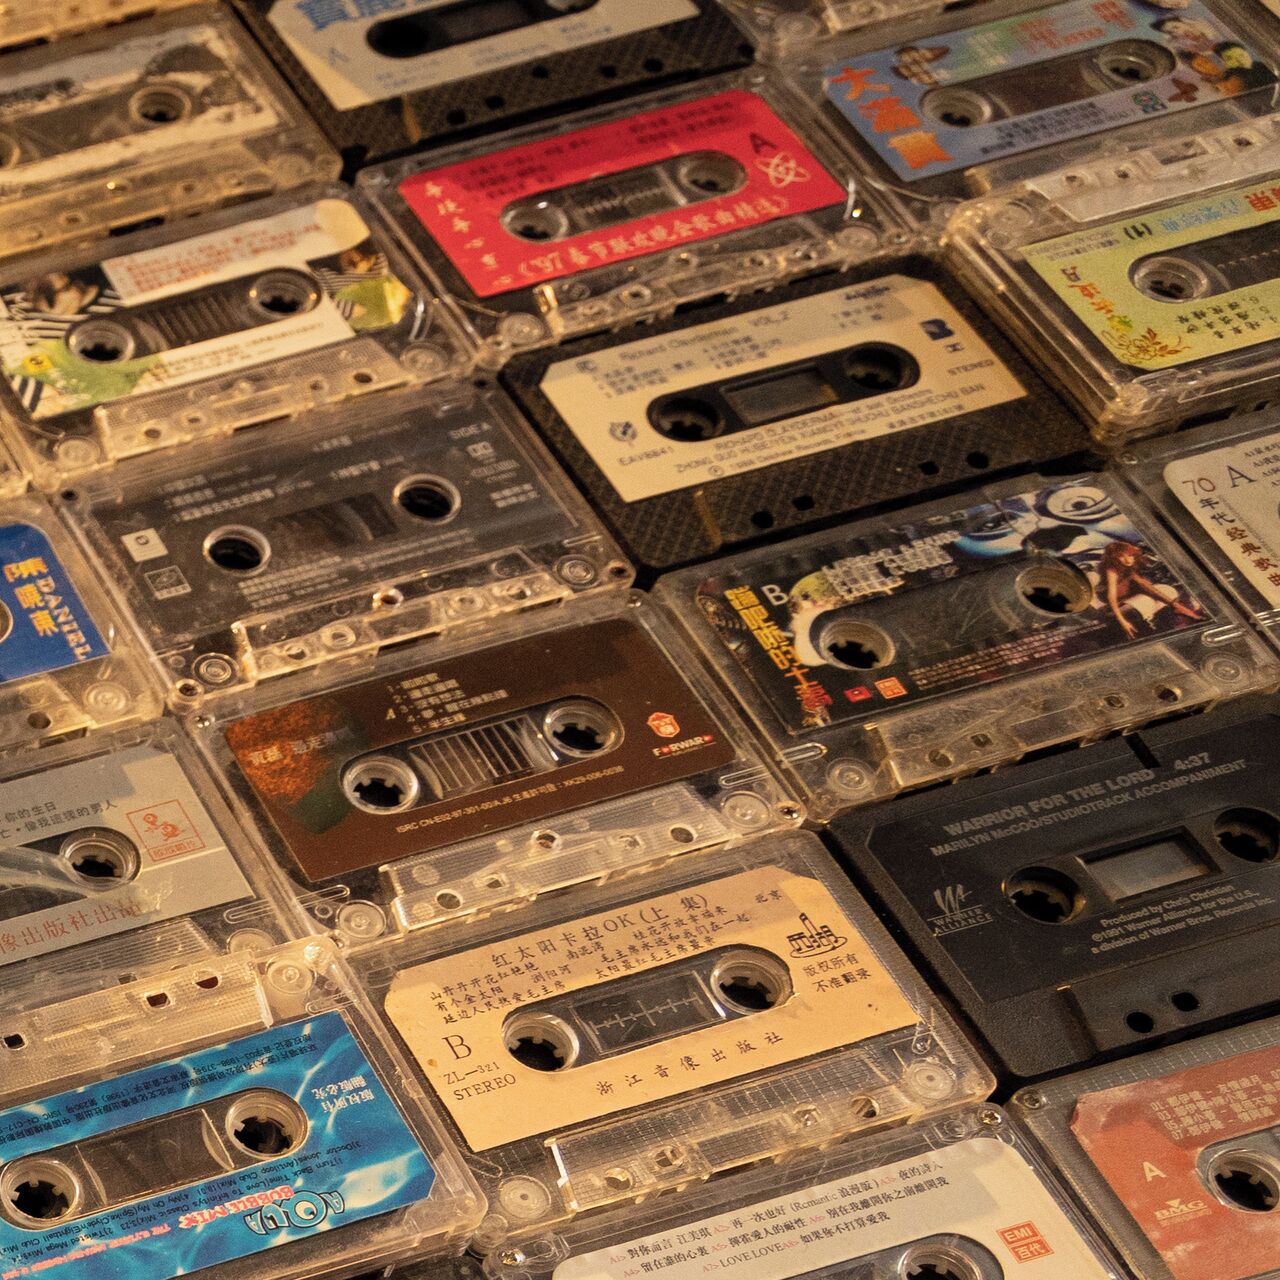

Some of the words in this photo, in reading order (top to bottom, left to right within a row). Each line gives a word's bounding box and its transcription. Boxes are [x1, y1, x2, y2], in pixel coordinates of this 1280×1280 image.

[742, 128, 780, 155] A
[949, 359, 994, 376] STEREO
[1227, 465, 1258, 488] A
[760, 582, 789, 606] B
[36, 576, 92, 660] DANIEL
[929, 830, 993, 857] MARILYN
[1131, 757, 1248, 800] ACCOMPANIMENT
[942, 803, 1026, 838] WARRIOR
[1027, 793, 1067, 813] FOR
[1065, 781, 1108, 802] THE
[1105, 767, 1157, 790] LORD
[1169, 750, 1213, 772] 4:37
[394, 821, 420, 834] ISRC
[752, 888, 785, 904] 北京
[1099, 907, 1149, 929] Produced
[1148, 903, 1164, 915] by
[1161, 895, 1190, 911] Chris
[1188, 881, 1235, 903] Christian
[933, 912, 994, 936] ALLIANCE
[936, 907, 985, 926] WARNER
[1097, 933, 1139, 953] division
[1148, 919, 1187, 938] Warner
[1185, 911, 1215, 927] Bros.
[1213, 899, 1255, 919] Records
[1123, 914, 1162, 933] Warner
[1160, 900, 1209, 923] Alliance
[800, 952, 862, 977] 版权所有
[433, 984, 505, 1013] 有个金太阳
[529, 964, 574, 984] 浏阳河
[810, 967, 873, 993] 不准翻录
[442, 1032, 474, 1060] B
[593, 1030, 787, 1097] 浙江音像出版社
[310, 1074, 367, 1100] 翻版必究
[451, 1072, 518, 1101] STEREO
[319, 1087, 375, 1113] 版权所有
[237, 1170, 258, 1182] Club
[290, 1165, 313, 1177] Back
[1143, 1160, 1167, 1182] A
[157, 1202, 190, 1218] Classic
[225, 1183, 296, 1216] BUBBLE
[237, 1180, 351, 1244] AQUA
[1154, 1198, 1209, 1220] BMG
[174, 1202, 230, 1230] MIX
[19, 1236, 40, 1249] Club
[626, 1237, 674, 1259] 對你而言
[675, 1226, 712, 1246] 江美琪
[730, 1204, 788, 1230] 再一次也好
[719, 1251, 751, 1268] LOVE
[798, 1209, 891, 1245] 如果你不打算愛我
[1002, 1225, 1035, 1242] EMI
[1014, 1241, 1046, 1258] 百代
